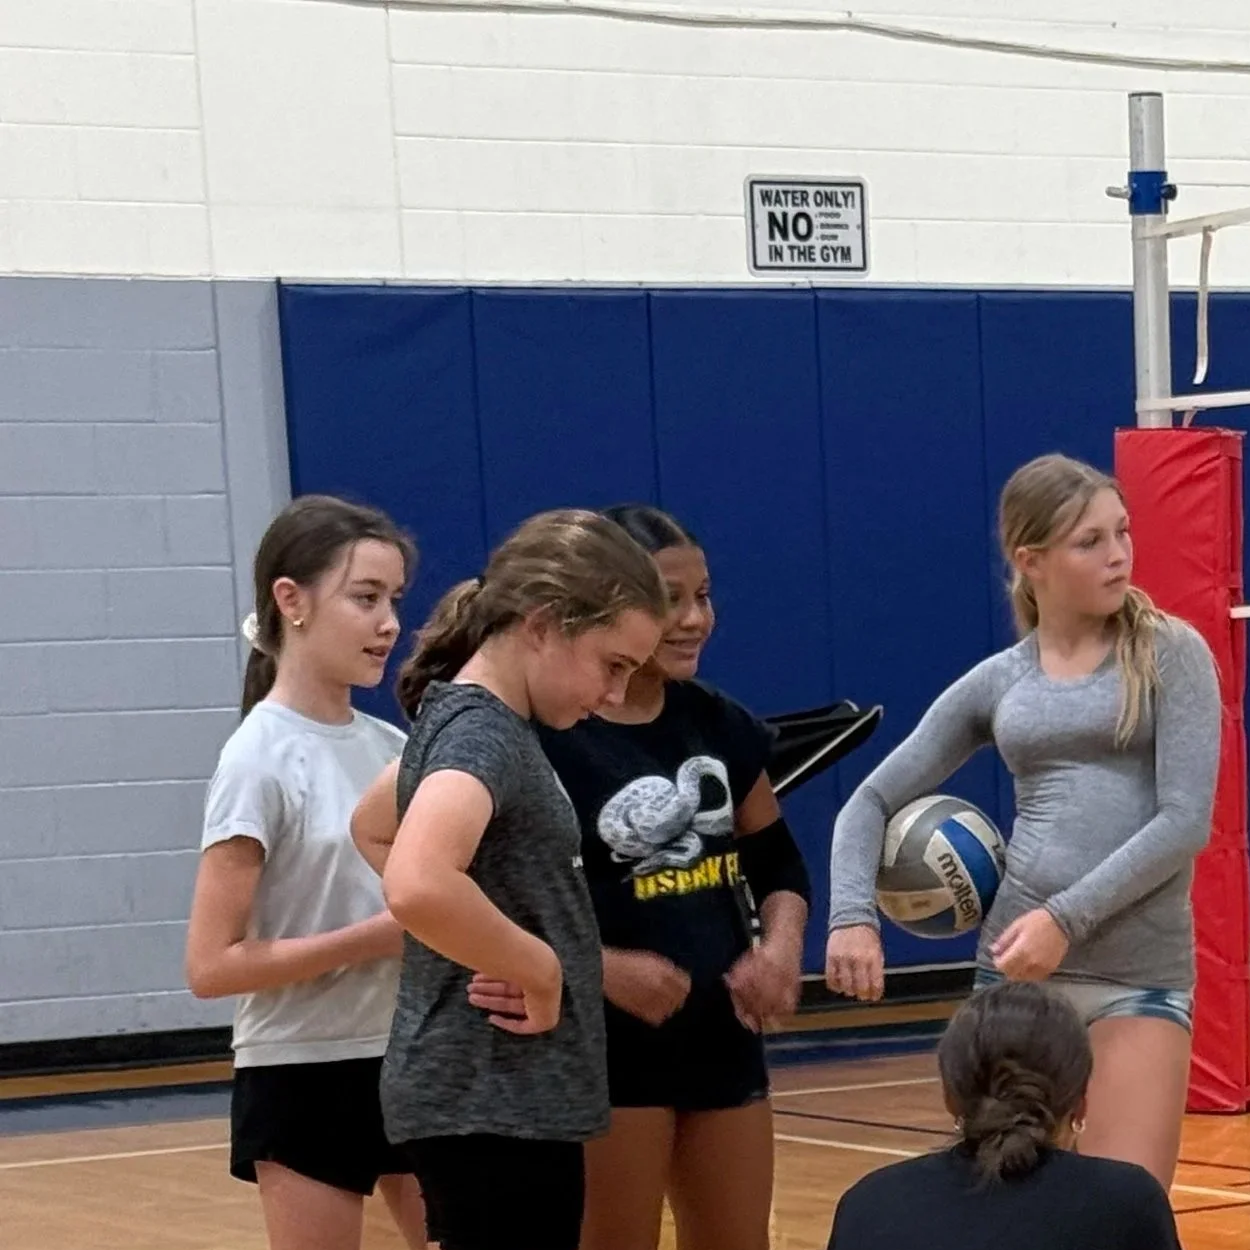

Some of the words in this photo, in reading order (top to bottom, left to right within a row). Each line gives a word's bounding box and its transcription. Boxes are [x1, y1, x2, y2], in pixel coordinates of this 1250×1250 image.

[759, 189, 810, 208] WATER
[813, 190, 855, 209] ONLY!
[767, 211, 814, 242] NO
[768, 244, 784, 262] IN
[787, 245, 817, 263] THE
[820, 245, 852, 264] GYM
[937, 852, 980, 922] molten
